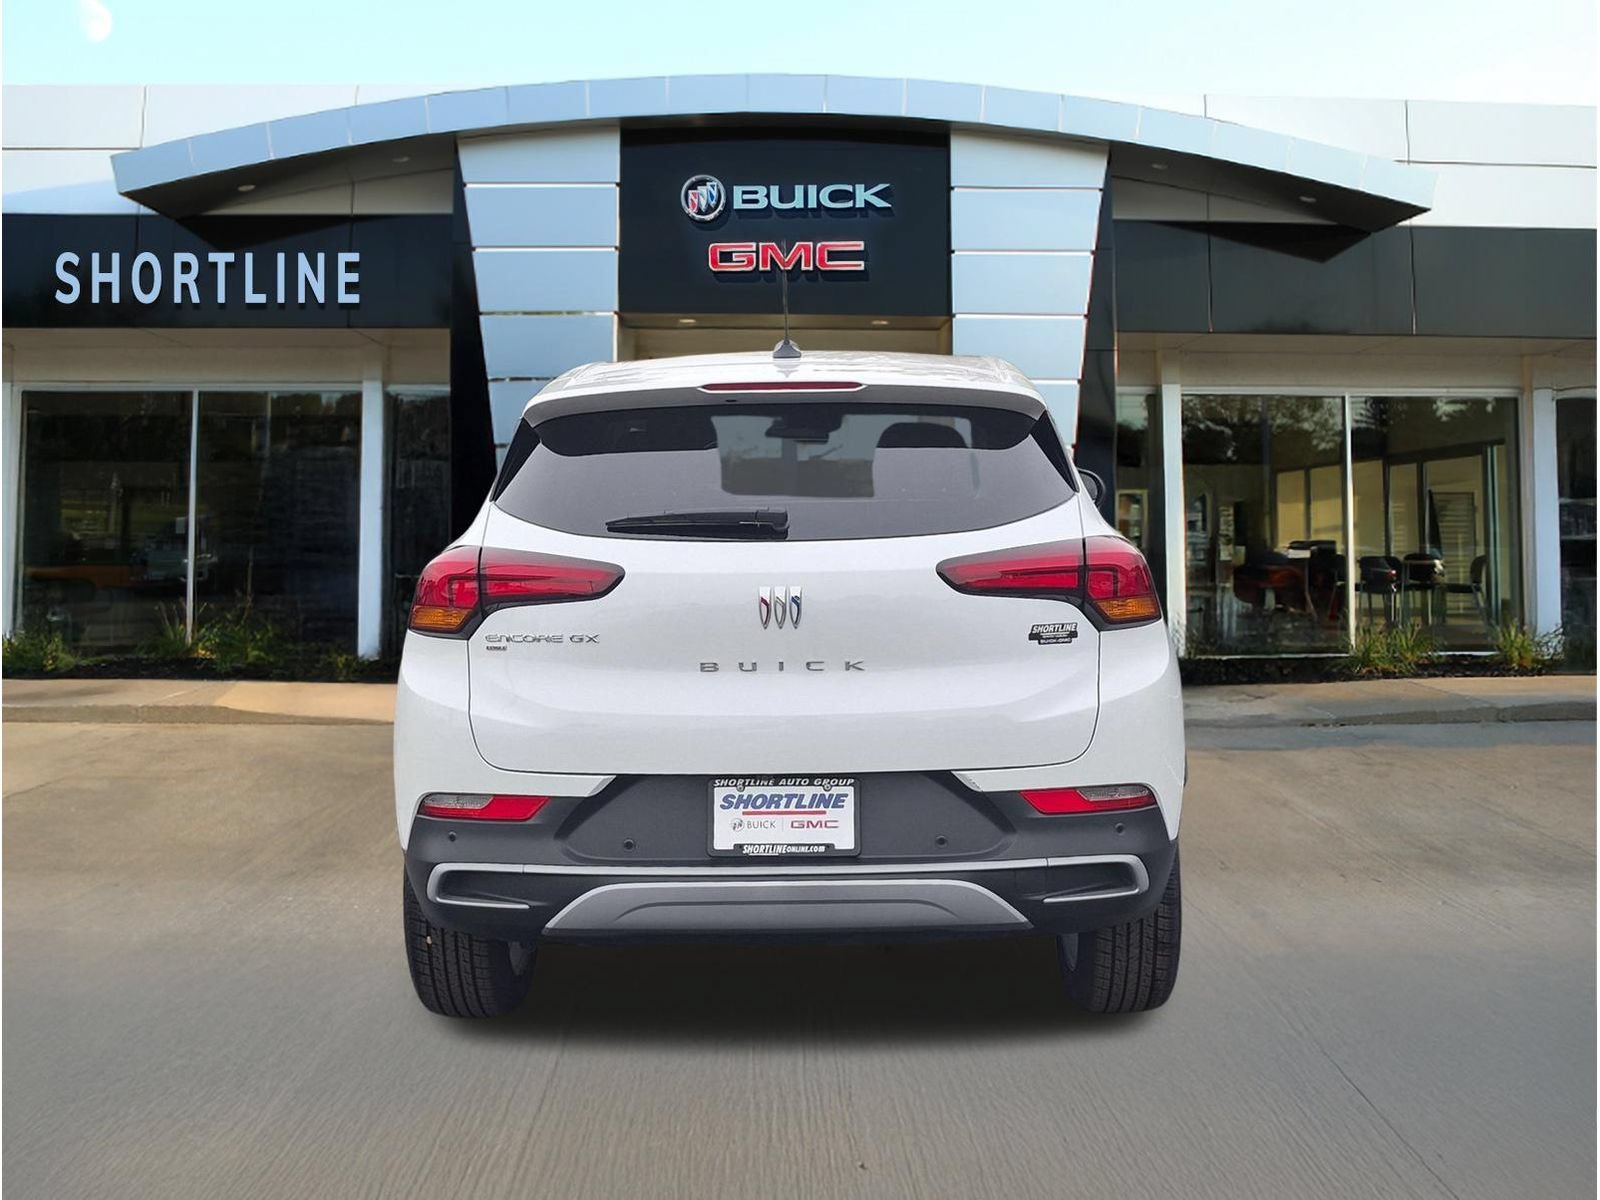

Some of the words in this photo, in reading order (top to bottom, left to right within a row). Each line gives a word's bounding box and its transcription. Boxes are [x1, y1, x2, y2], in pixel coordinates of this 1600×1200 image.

[733, 184, 892, 209] BUICK
[709, 241, 864, 272] GMC
[54, 251, 360, 305] SHORTLINE
[1032, 623, 1077, 633] SHORTLINE
[569, 634, 600, 643] GX
[699, 661, 865, 672] BUICK
[714, 778, 775, 786] SHORTLINE
[779, 778, 810, 786] AUTO
[814, 778, 854, 786] GROUP
[720, 793, 848, 810] SHORTLINE
[747, 820, 777, 829] BUICK
[790, 820, 839, 829] GMC
